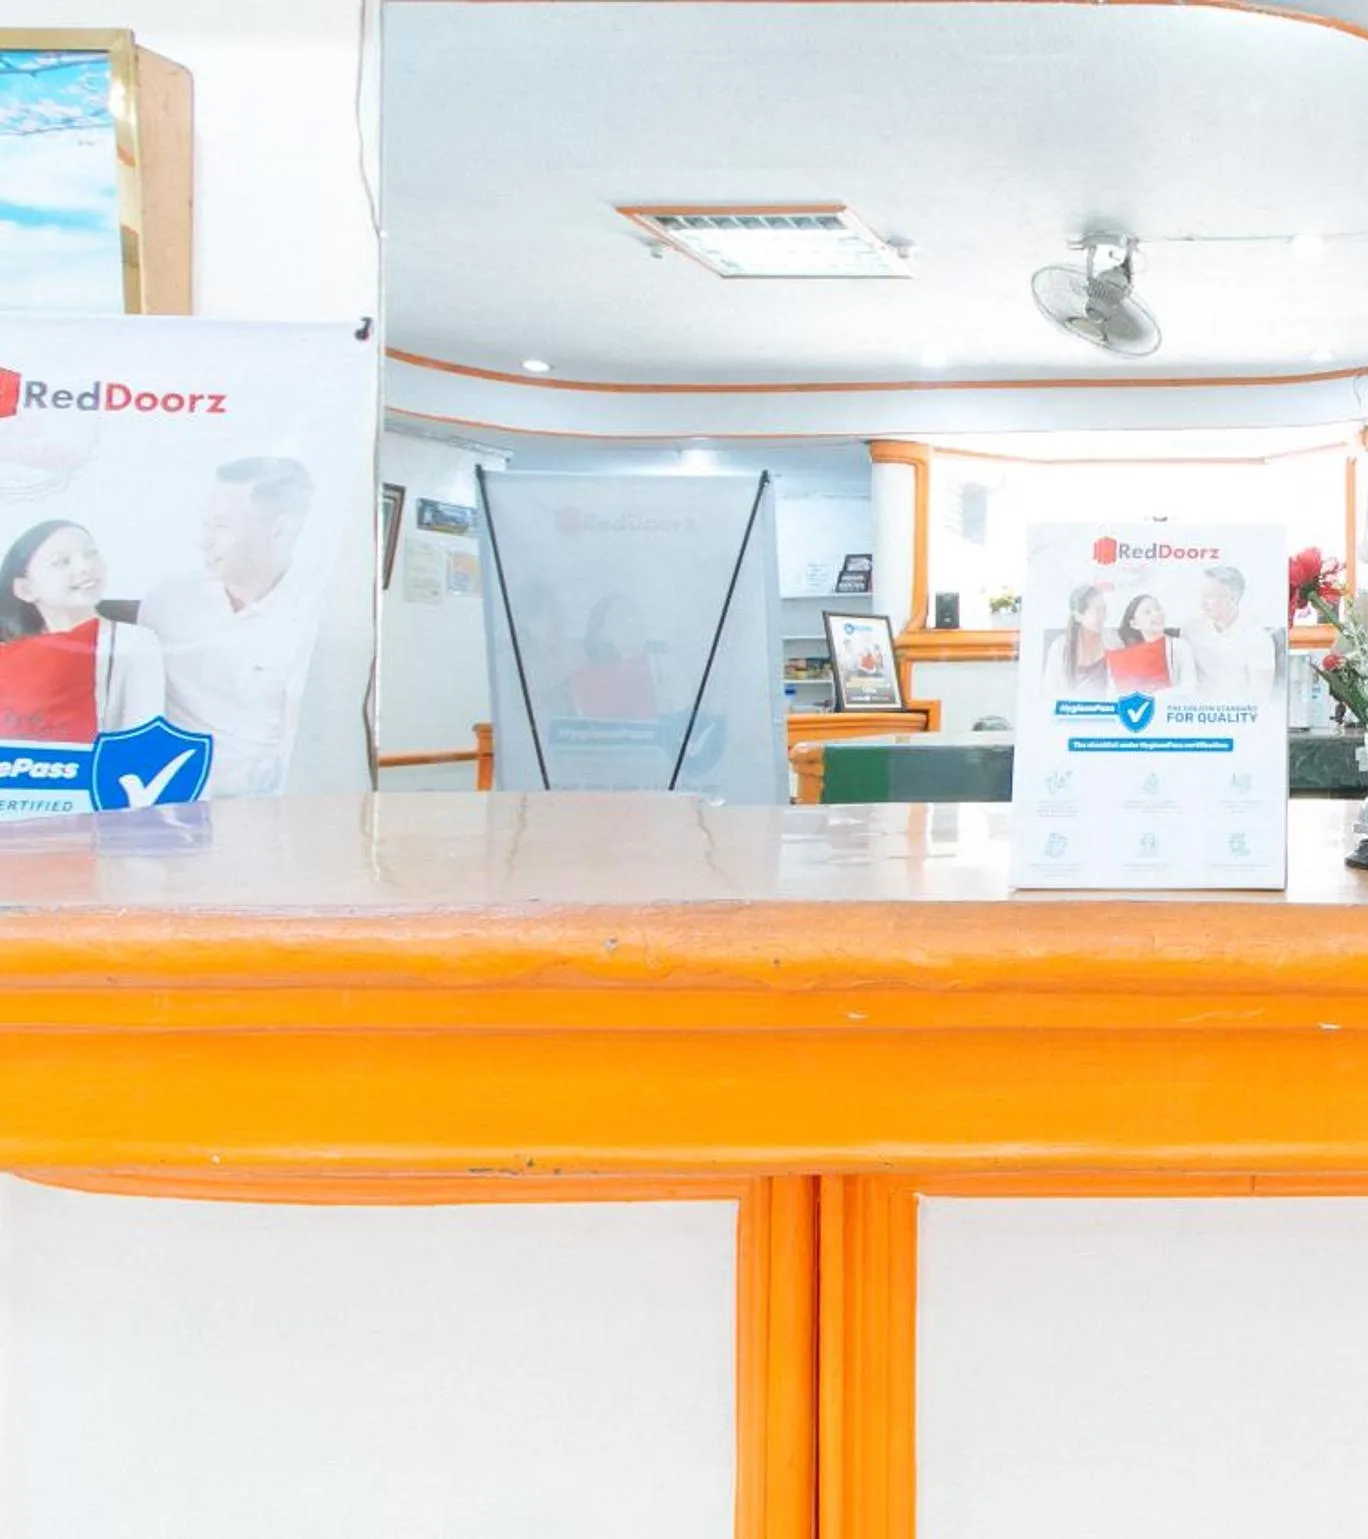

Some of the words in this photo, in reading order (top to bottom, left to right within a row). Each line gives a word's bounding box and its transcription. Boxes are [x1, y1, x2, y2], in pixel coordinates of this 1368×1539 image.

[23, 381, 227, 413] RedDoorz
[1117, 542, 1221, 560] RedDoorz
[1166, 712, 1194, 723] FOR
[1198, 712, 1259, 725] QUALITY
